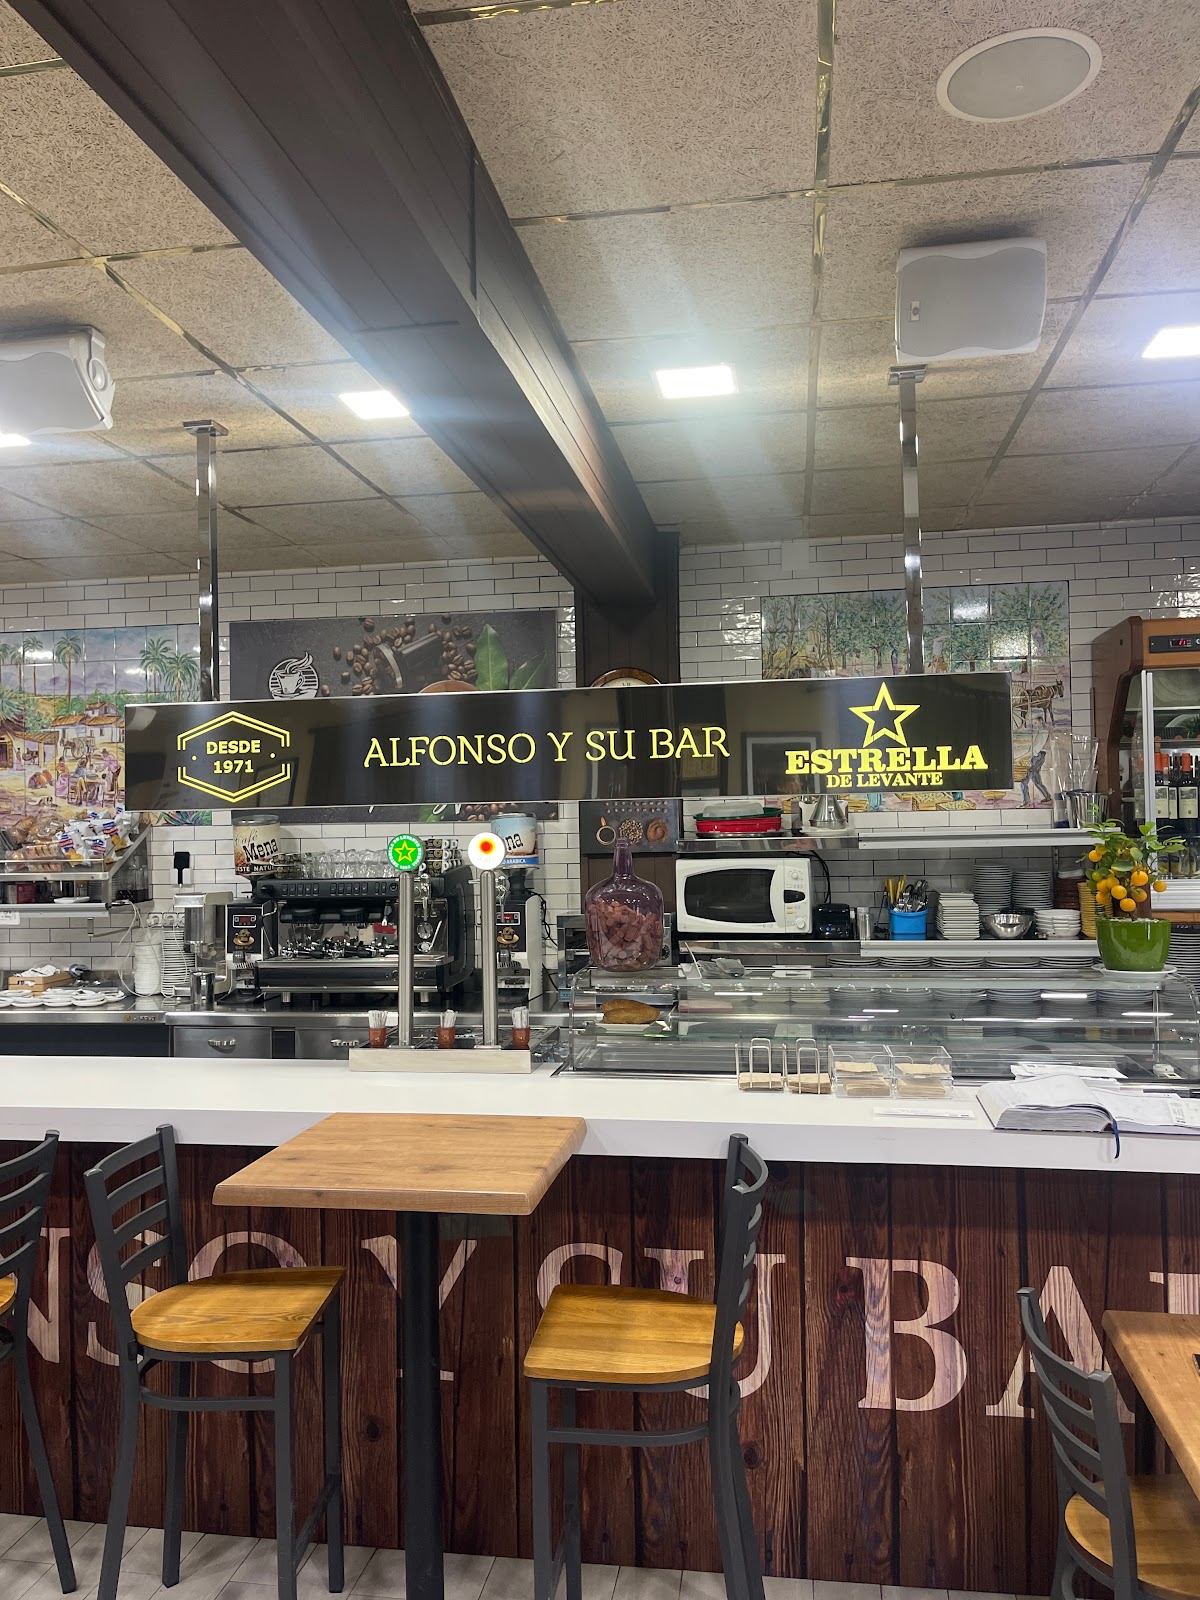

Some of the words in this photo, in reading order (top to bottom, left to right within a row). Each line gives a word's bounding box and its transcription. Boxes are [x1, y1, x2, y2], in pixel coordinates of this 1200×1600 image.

[206, 739, 261, 755] DESDE
[364, 733, 536, 768] ALFONSO
[548, 731, 573, 762] Y
[585, 729, 635, 762] SU
[649, 726, 730, 760] BAR
[213, 759, 254, 774] 1971
[785, 745, 989, 775] ESTRELLA
[826, 774, 853, 788] DE
[856, 771, 943, 788] LEVANTE
[242, 838, 279, 863] Mena
